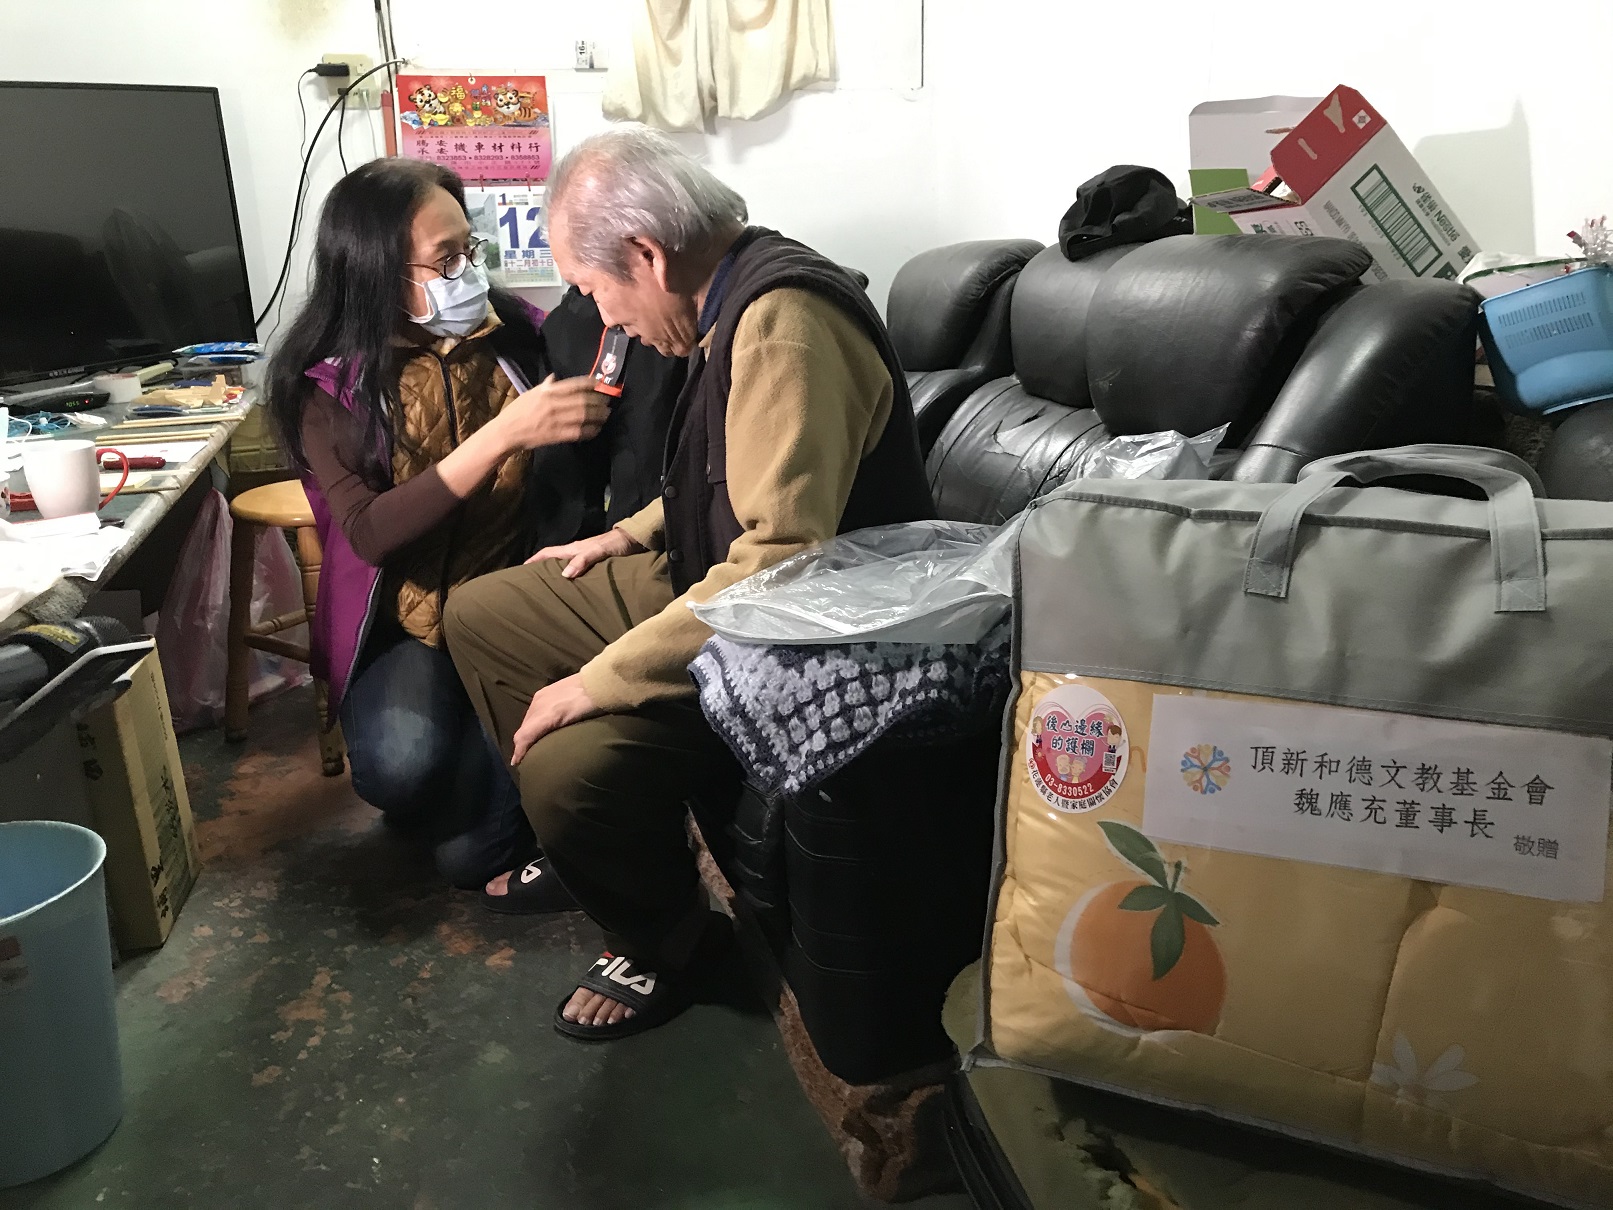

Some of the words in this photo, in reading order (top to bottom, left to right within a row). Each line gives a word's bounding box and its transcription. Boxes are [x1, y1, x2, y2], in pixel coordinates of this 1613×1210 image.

[454, 142, 541, 154] 機車材料行
[499, 206, 550, 249] 12
[504, 249, 552, 259] 星期三
[1045, 773, 1094, 797] 03-8330522
[1250, 745, 1555, 806] 頂新和德文教基金會
[1293, 788, 1495, 839] 魏應充董事長
[1513, 835, 1560, 860] 敬贈
